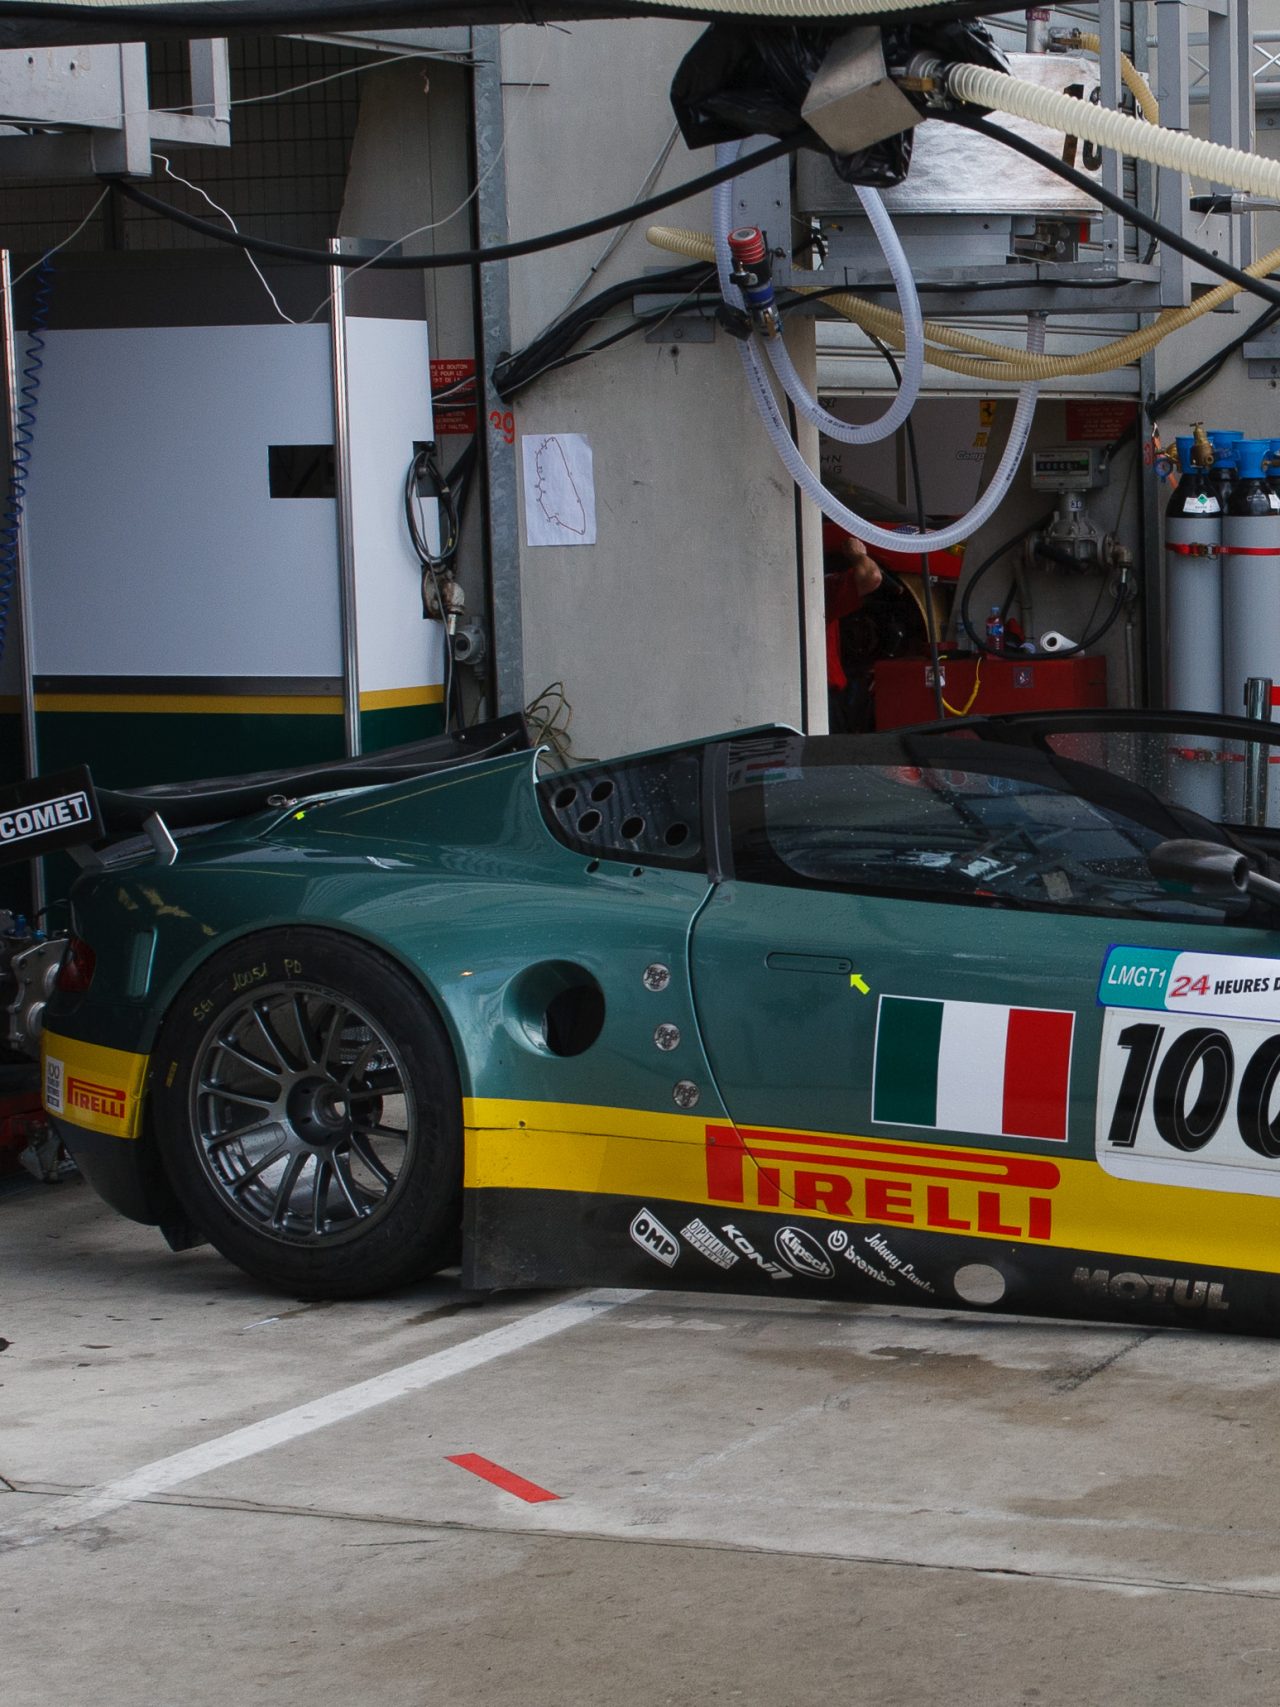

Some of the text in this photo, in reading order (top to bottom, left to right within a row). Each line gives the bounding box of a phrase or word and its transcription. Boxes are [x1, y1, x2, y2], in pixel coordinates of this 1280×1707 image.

[0, 798, 86, 839] COMET
[1107, 965, 1167, 988] LMGT1
[1168, 975, 1210, 998] 24
[1214, 978, 1269, 995] HEURES
[67, 1076, 126, 1119] PIRELLI
[705, 1124, 1061, 1240] PIRELLI
[635, 1219, 674, 1256] OMP
[688, 1219, 738, 1266] OPTIMA
[721, 1224, 793, 1279] KONI
[779, 1229, 831, 1275] Klipsch
[864, 1233, 902, 1269] Johnny
[844, 1245, 896, 1287] brembo
[1071, 1266, 1230, 1310] MOTUL
